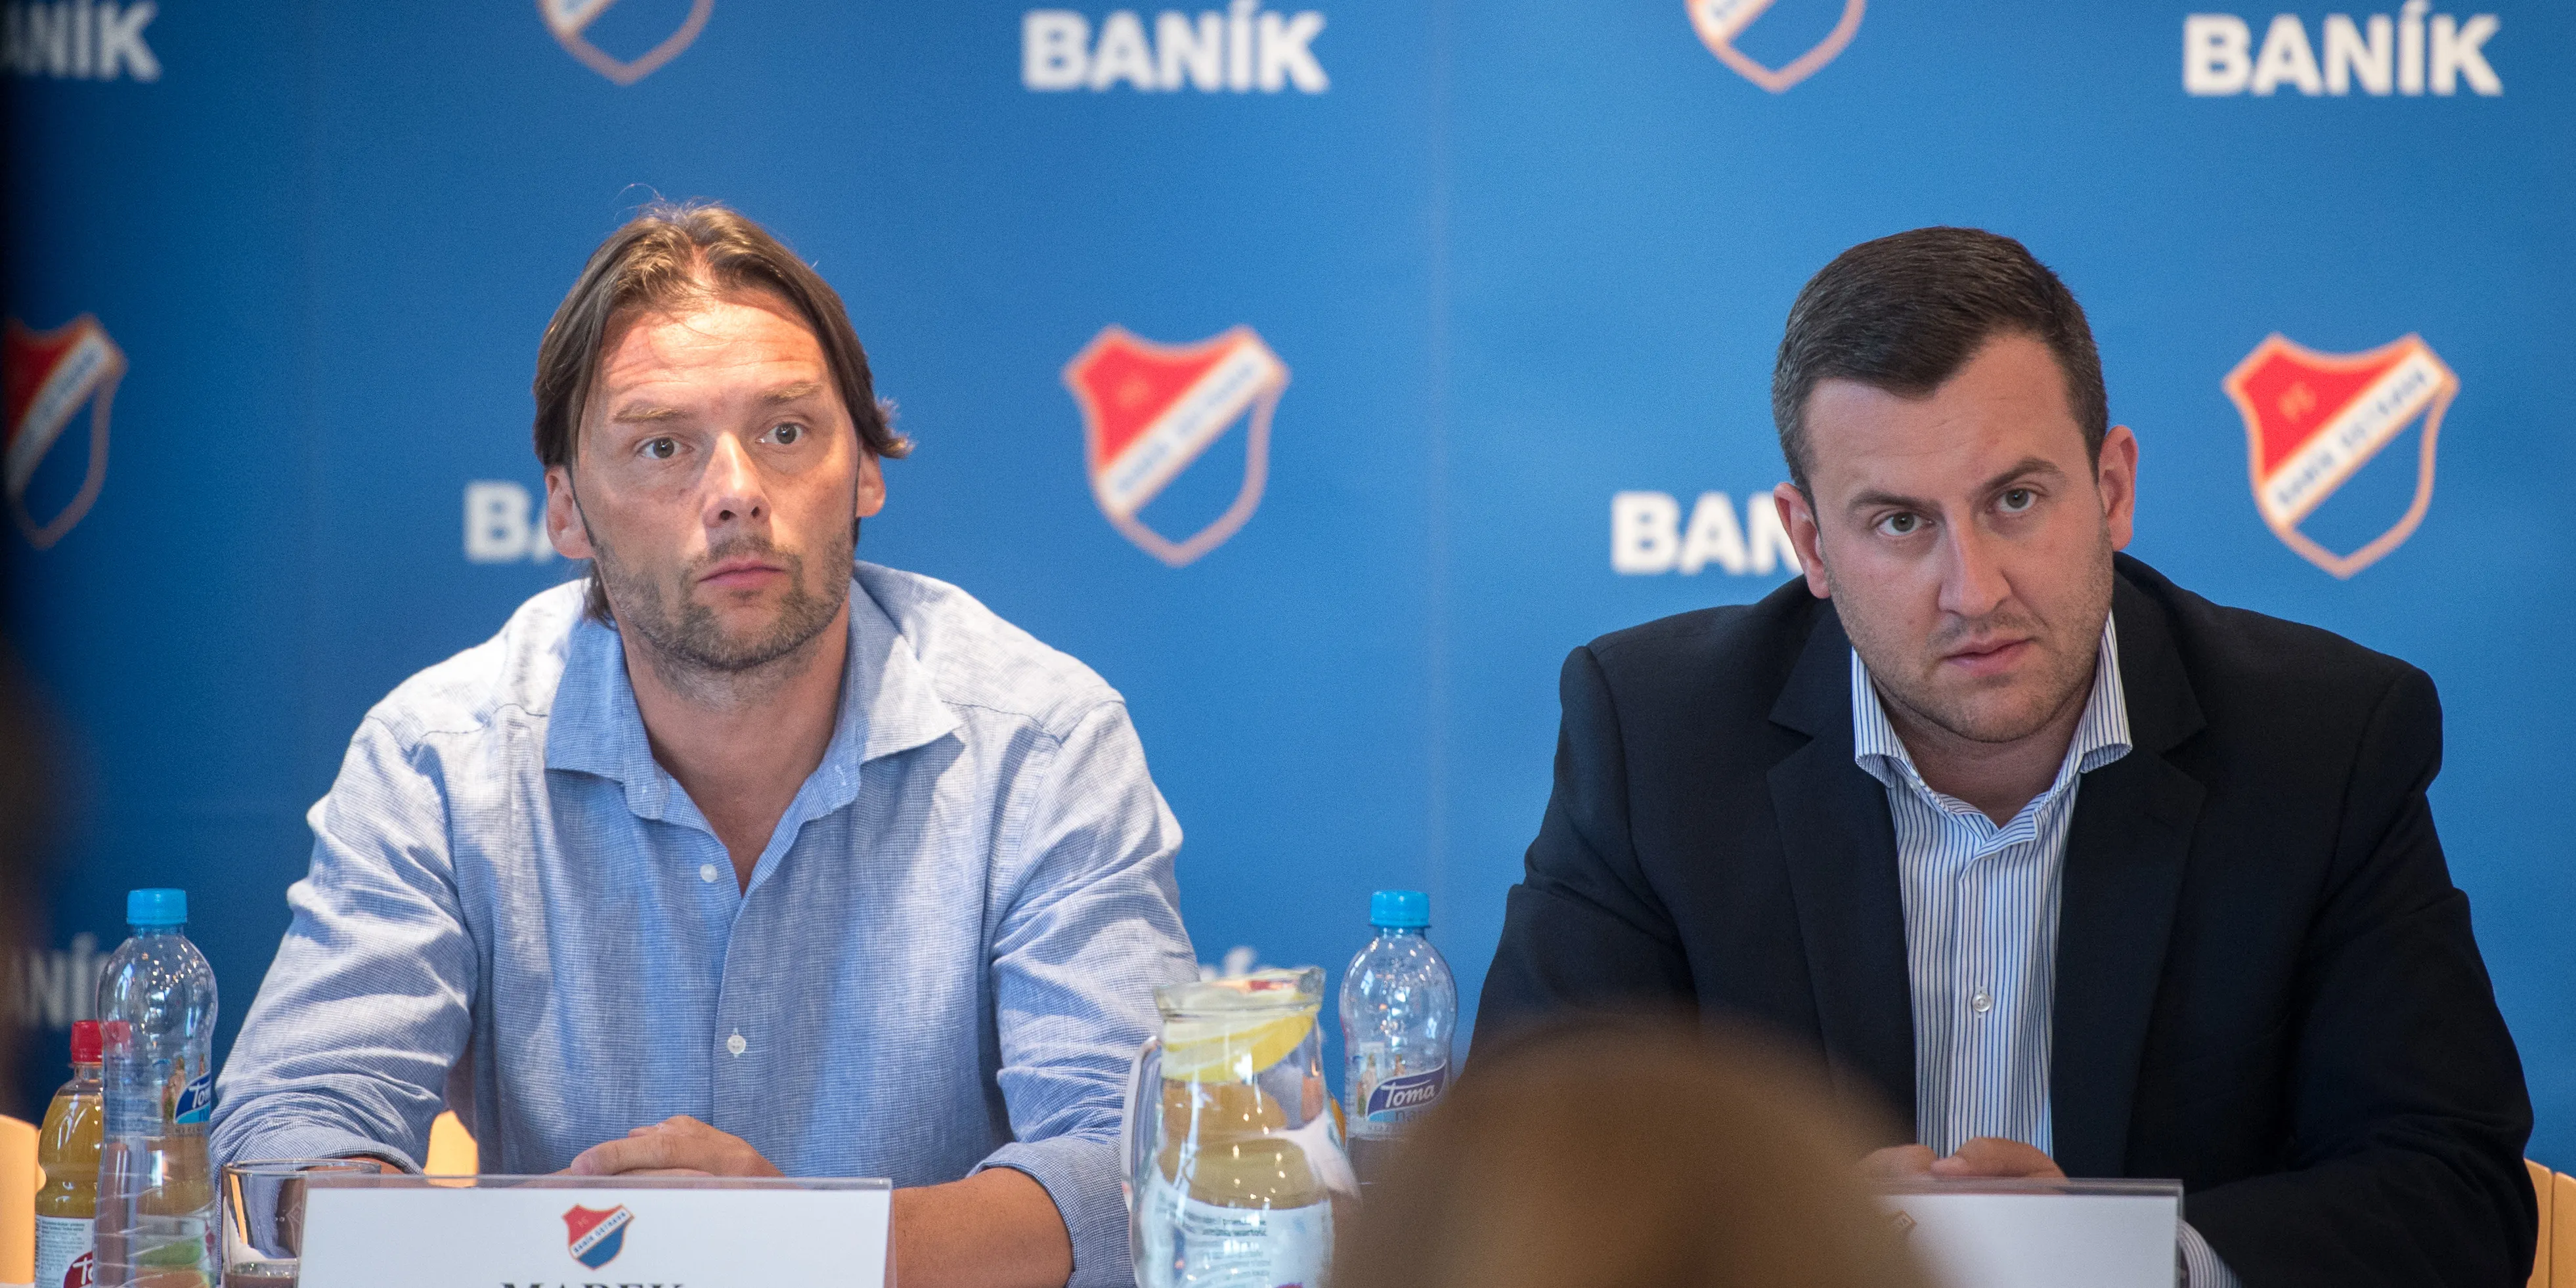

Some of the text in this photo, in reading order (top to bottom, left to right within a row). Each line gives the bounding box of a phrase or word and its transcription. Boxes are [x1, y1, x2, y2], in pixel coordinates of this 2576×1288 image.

[1022, 0, 1328, 92] BANÍK
[2183, 0, 2502, 96] BANÍK
[1611, 490, 1806, 575] BAN
[1381, 1079, 1435, 1108] Toma
